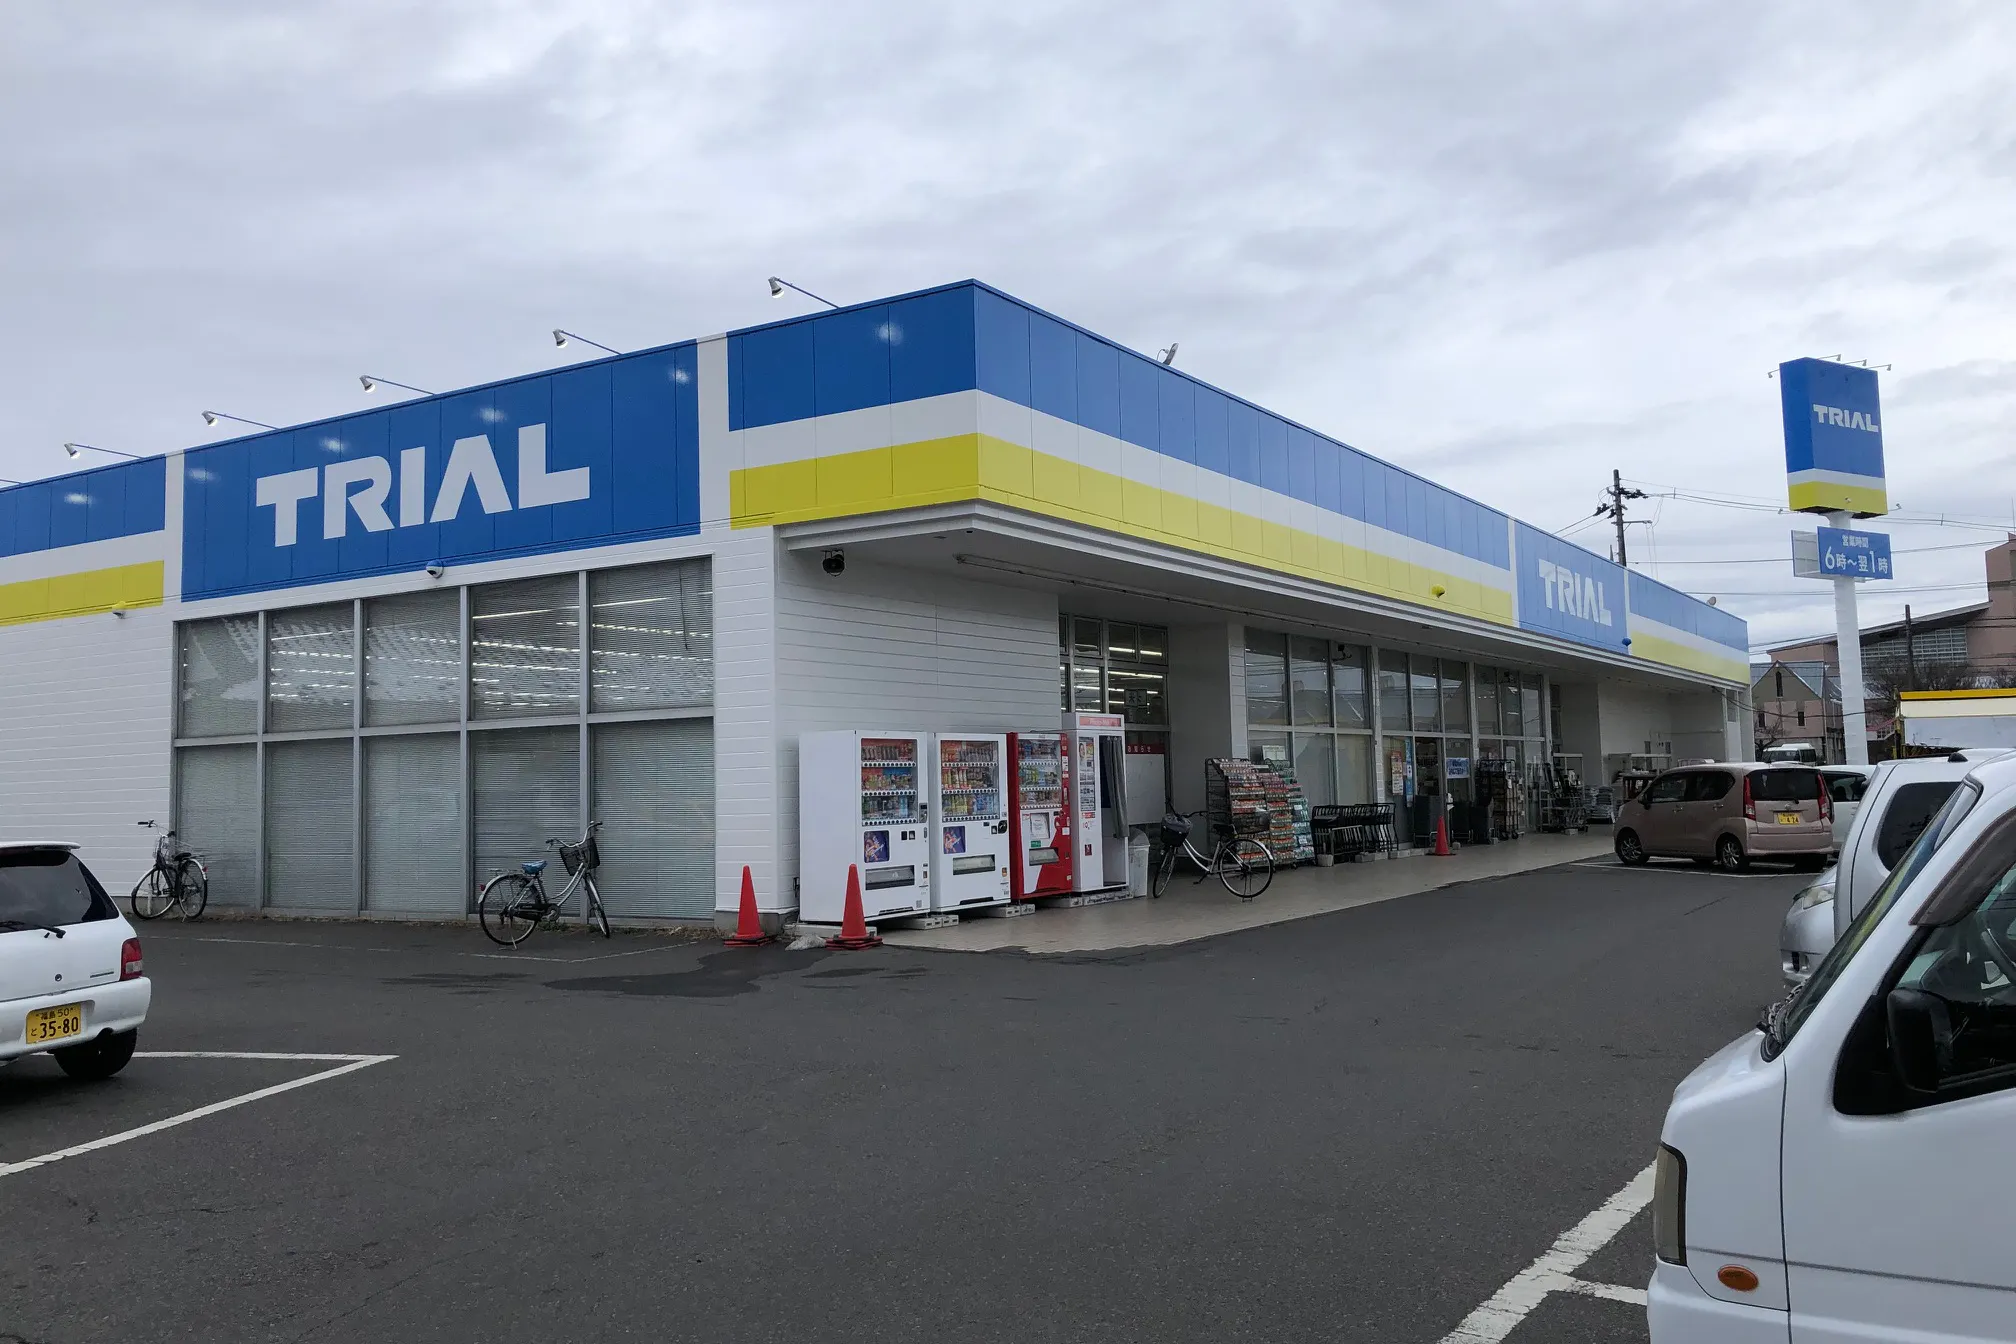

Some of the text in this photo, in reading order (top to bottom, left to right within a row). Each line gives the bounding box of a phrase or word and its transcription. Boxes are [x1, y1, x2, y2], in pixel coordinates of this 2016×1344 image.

[1812, 404, 1879, 433] TRIAL
[256, 422, 590, 548] TRIAL
[1538, 558, 1612, 627] TRIAL
[39, 1016, 79, 1039] 35-80
[57, 1008, 70, 1018] 50
